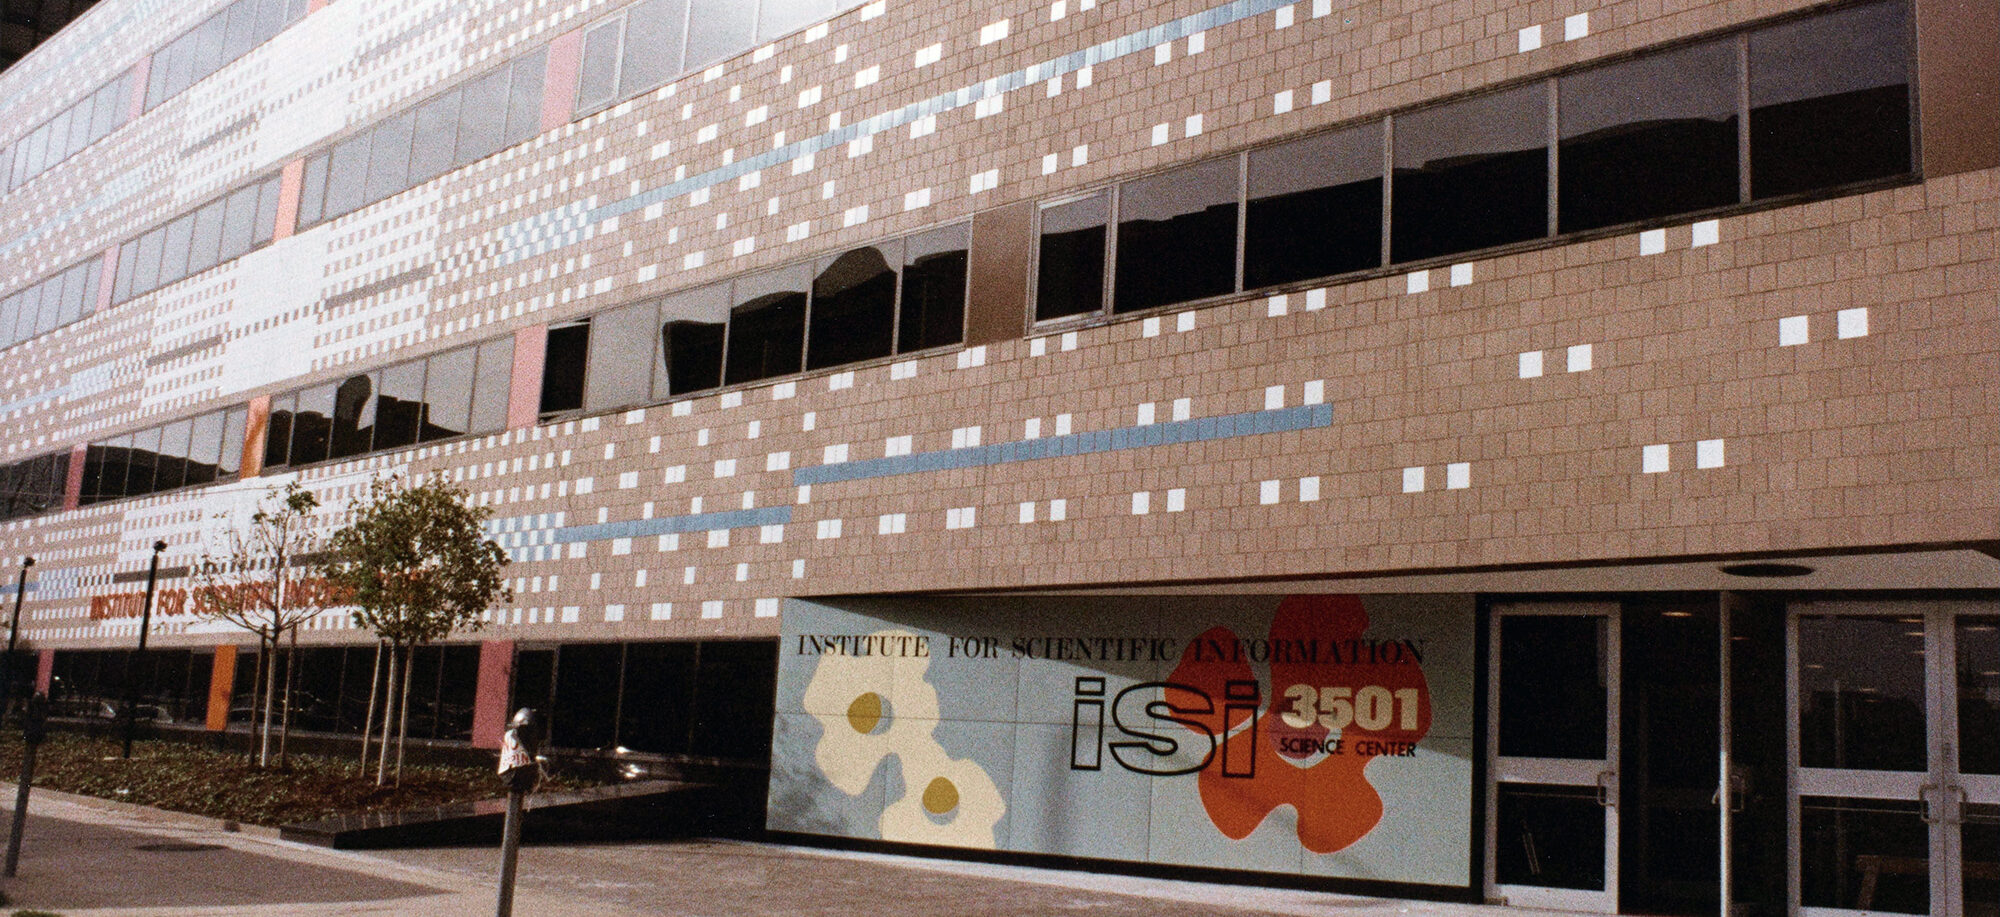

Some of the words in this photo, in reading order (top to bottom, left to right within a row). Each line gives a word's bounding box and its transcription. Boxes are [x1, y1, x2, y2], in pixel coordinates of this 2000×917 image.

[90, 590, 152, 620] INSTITUT
[156, 586, 187, 616] FOR
[797, 634, 930, 658] INSTITUTE
[949, 636, 999, 659] FOR
[1011, 636, 1176, 662] SCIENTIFIC
[1193, 638, 1426, 665] INFORMATION
[1281, 683, 1419, 731] 3501
[1280, 737, 1344, 756] SCIENCE
[1355, 741, 1417, 758] CENTER
